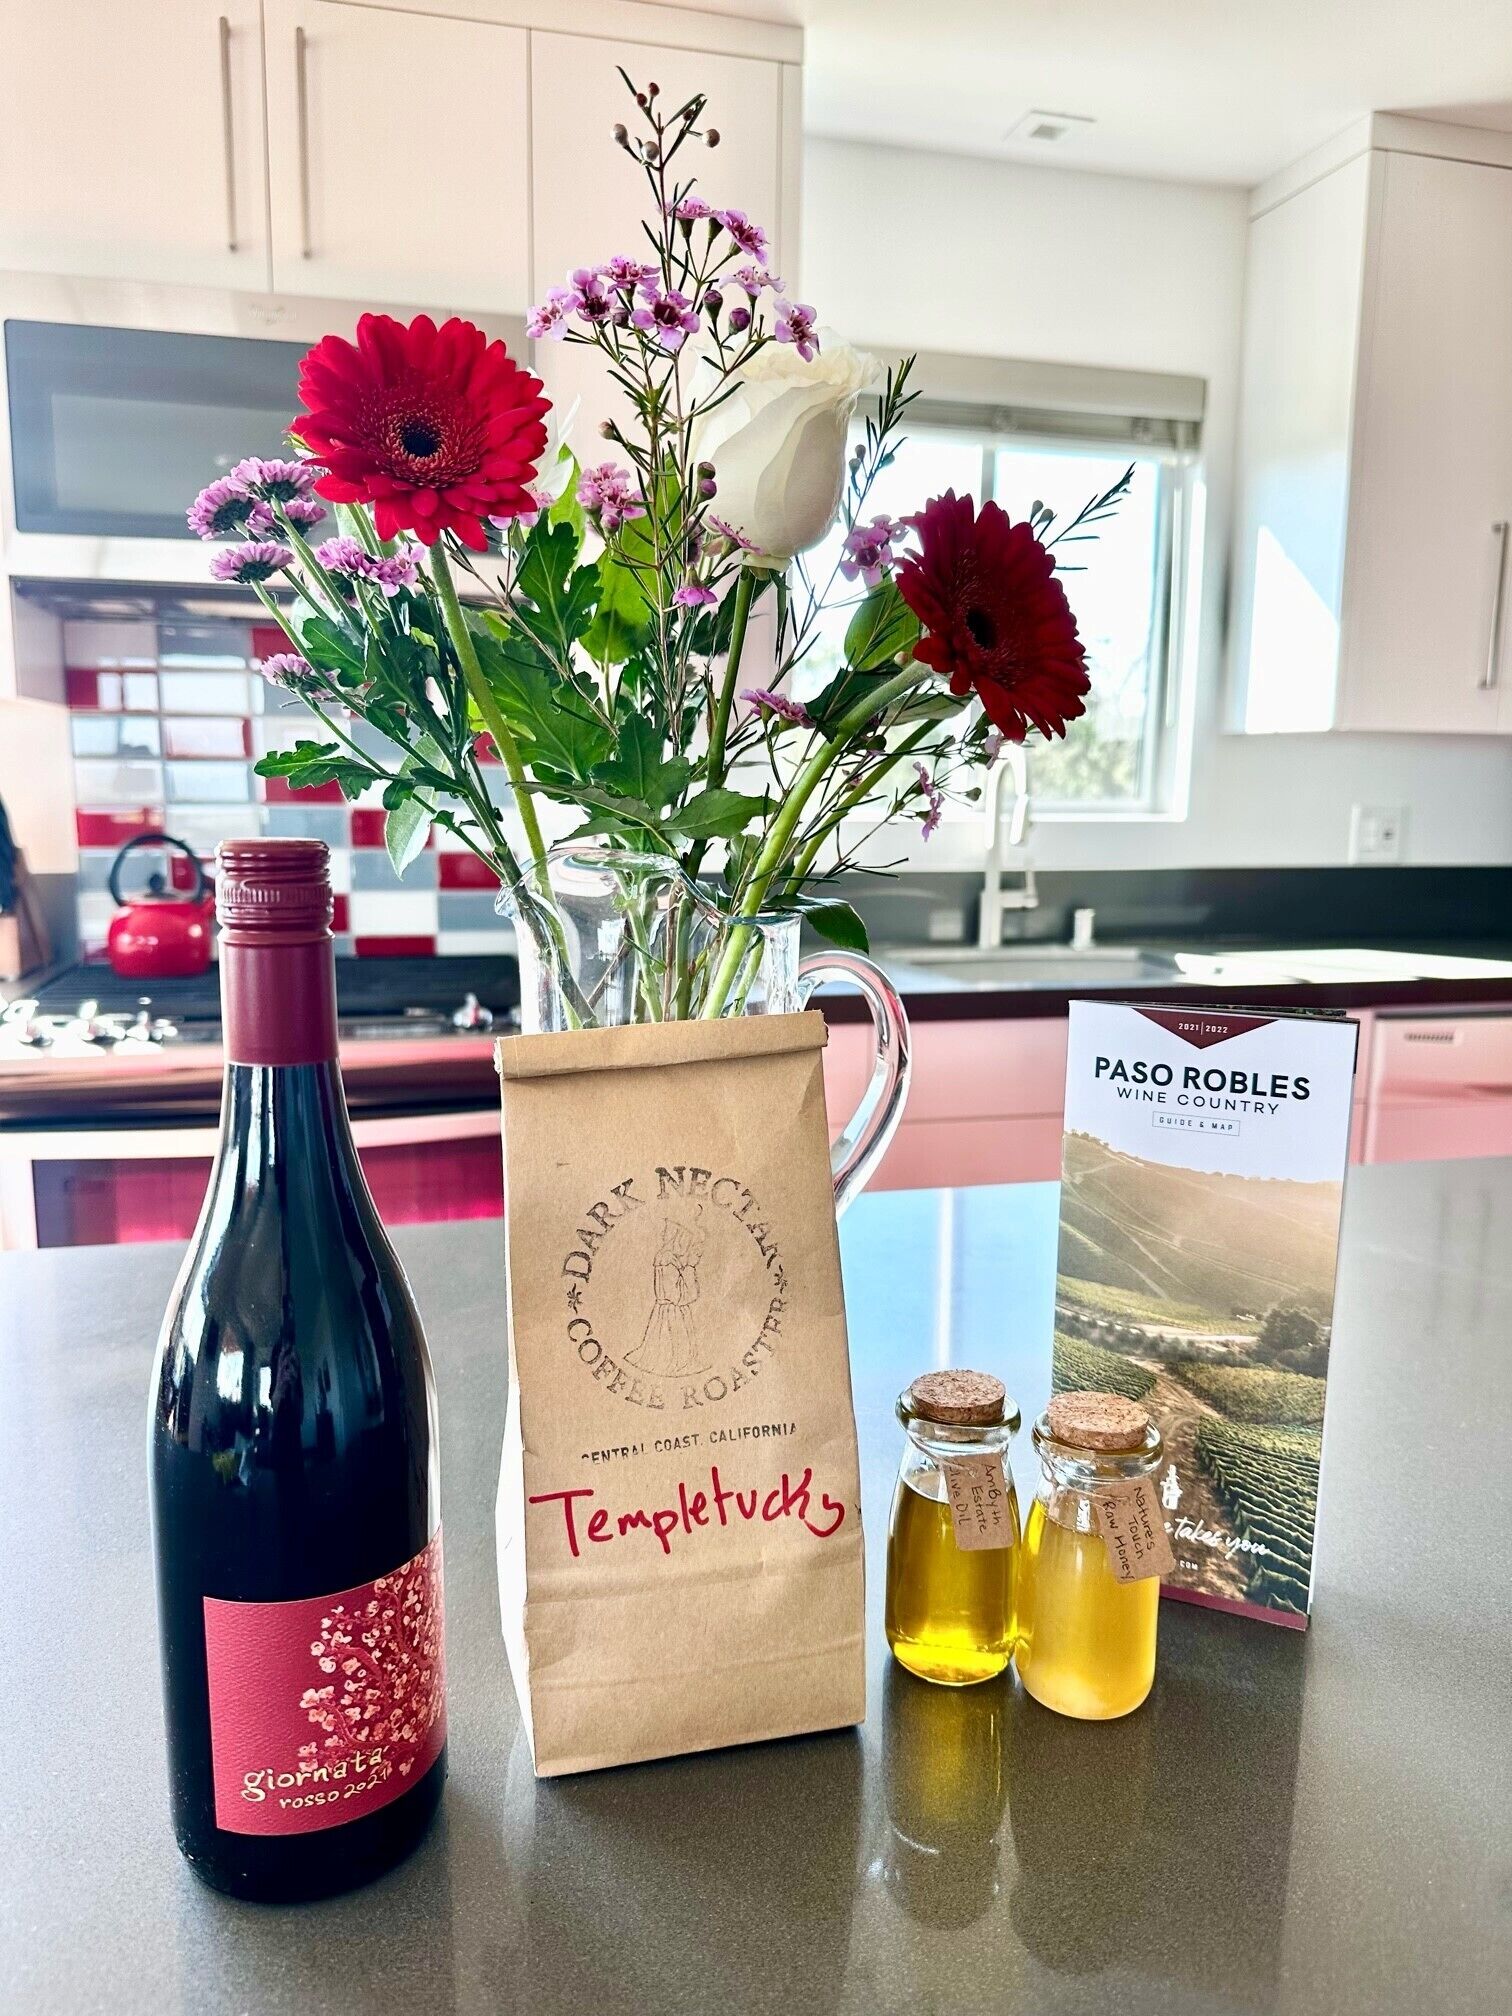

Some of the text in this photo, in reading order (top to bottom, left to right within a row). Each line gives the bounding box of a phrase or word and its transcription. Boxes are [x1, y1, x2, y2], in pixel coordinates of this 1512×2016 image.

[1178, 1022, 1229, 1034] 2021 2022
[1095, 1056, 1311, 1101] PASO ROBLES
[1116, 1086, 1280, 1115] WINE COUNTRY
[1159, 1116, 1193, 1128] GUIDE
[1211, 1122, 1234, 1131] MAP
[560, 1166, 783, 1284] DARK NECTAR
[567, 1297, 787, 1410] COFFEE ROASTER
[709, 1422, 798, 1444] CALIFORNIA
[956, 1503, 972, 1526] Oil
[971, 1485, 987, 1534] Estate
[1134, 1486, 1156, 1551] Nature's
[1103, 1500, 1135, 1580] Raw Honey
[1128, 1514, 1144, 1560] Touch
[1175, 1516, 1223, 1547] takes
[1225, 1536, 1271, 1560] you
[279, 1768, 388, 1810] rosso 2021
